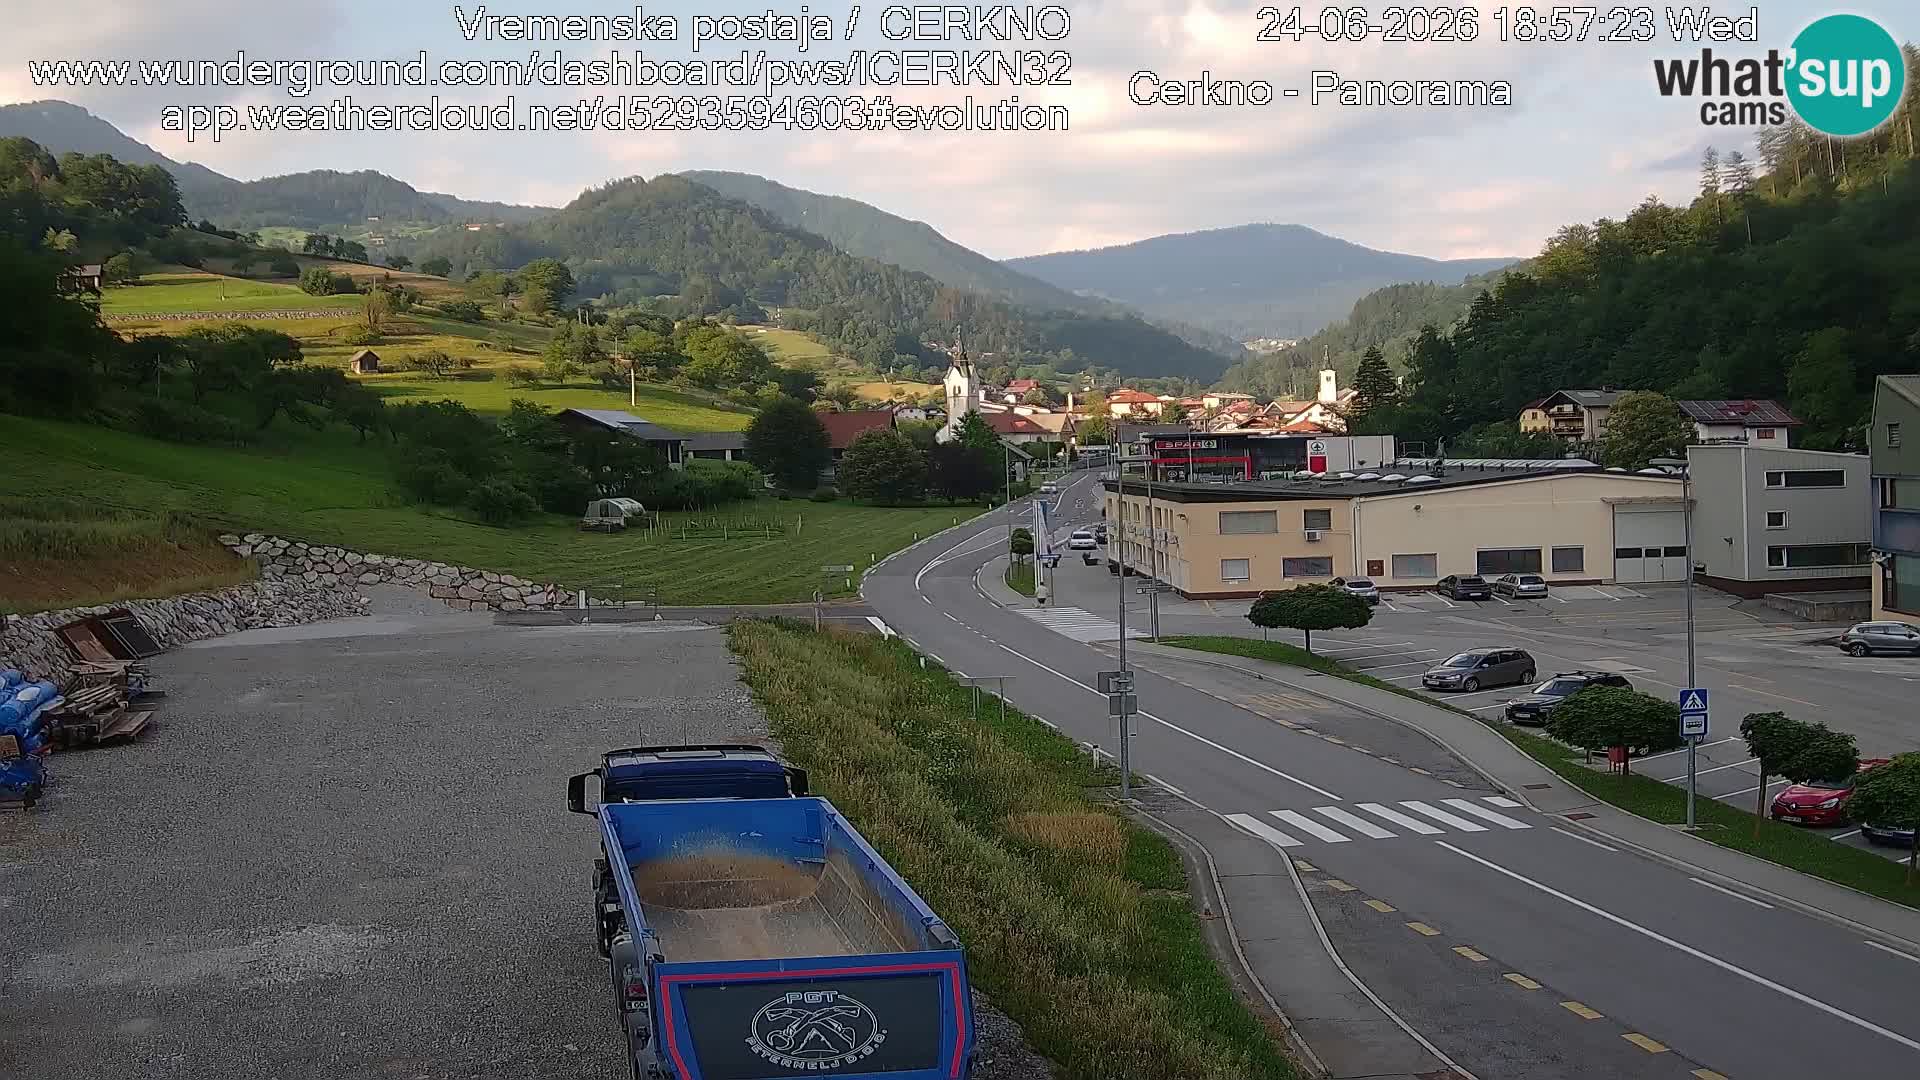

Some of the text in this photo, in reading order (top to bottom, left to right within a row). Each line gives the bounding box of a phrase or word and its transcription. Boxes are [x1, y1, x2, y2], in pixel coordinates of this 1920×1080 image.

[1165, 440, 1202, 449] SPAR
[785, 990, 839, 1005] PGT
[745, 1036, 841, 1070] PETERNELJ
